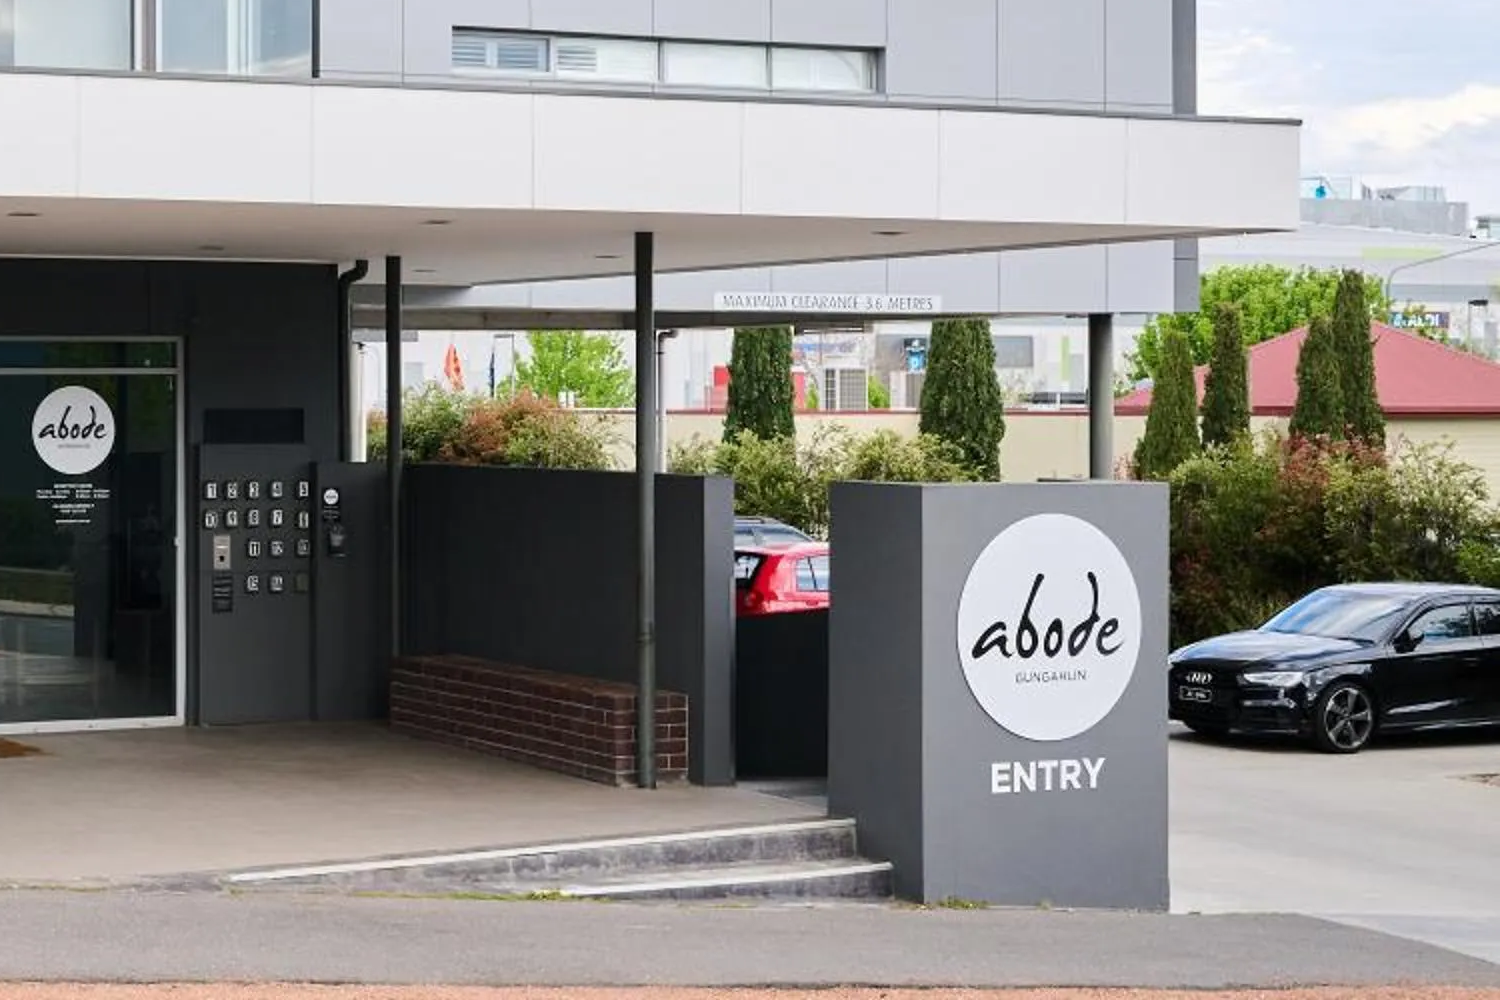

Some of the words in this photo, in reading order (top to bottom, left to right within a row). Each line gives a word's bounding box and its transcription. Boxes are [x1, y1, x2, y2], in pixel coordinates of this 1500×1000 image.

[723, 295, 788, 309] MAXIMUM
[791, 295, 858, 310] CLEARANCE
[887, 297, 933, 310] METRES
[38, 405, 107, 439] abode
[971, 571, 1125, 658] abode
[1015, 669, 1087, 683] GUNGAHLIN
[991, 757, 1106, 794] ENTRY
